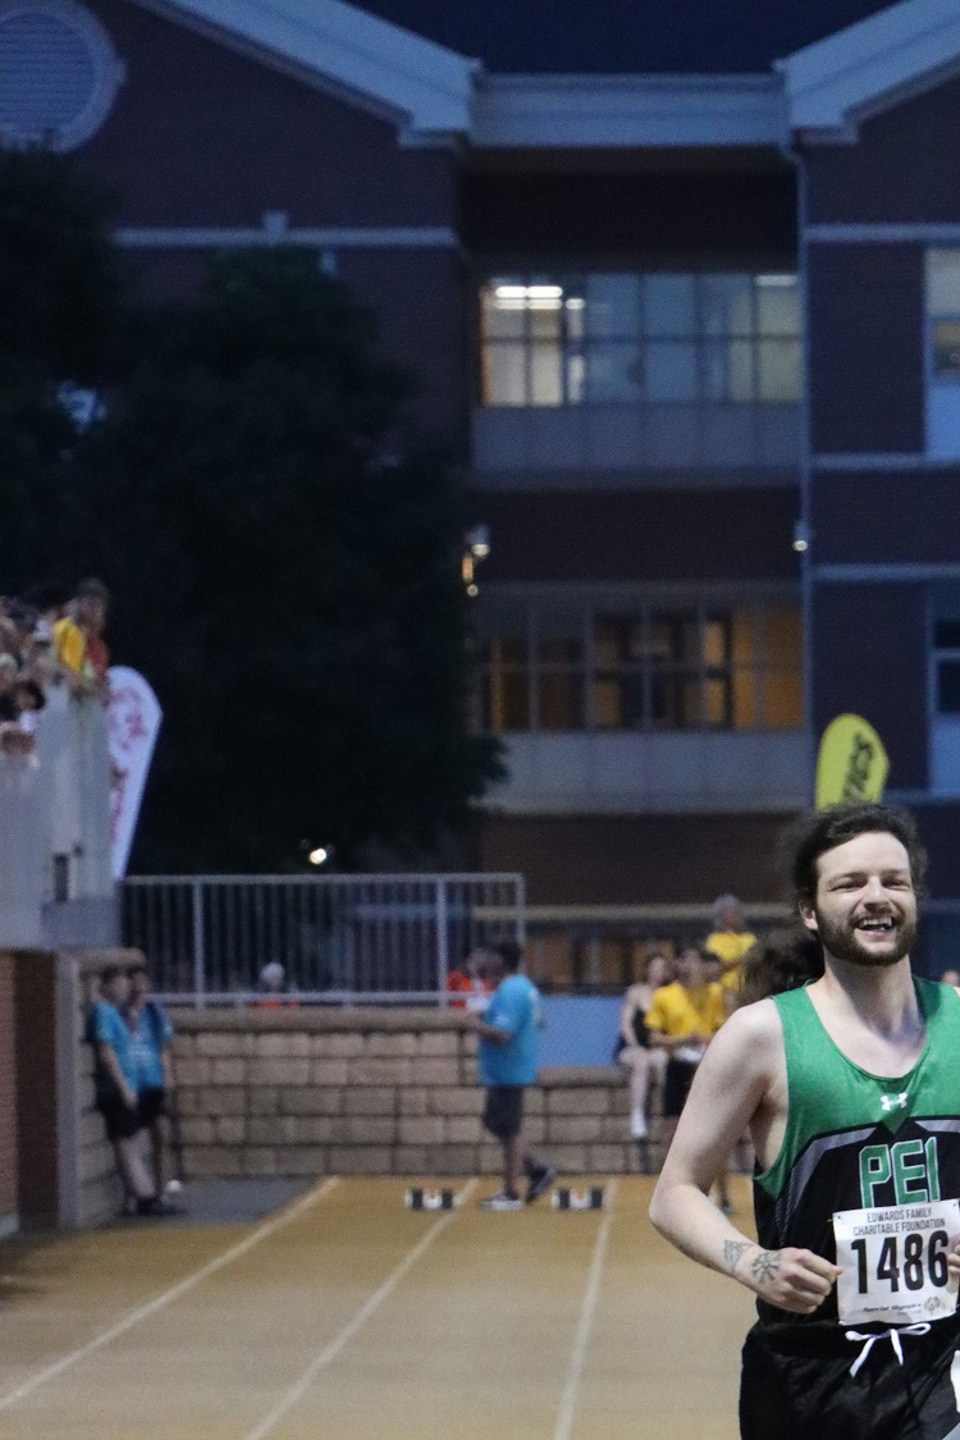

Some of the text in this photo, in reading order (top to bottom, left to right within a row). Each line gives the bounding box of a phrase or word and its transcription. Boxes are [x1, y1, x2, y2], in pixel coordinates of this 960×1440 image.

[859, 1136, 941, 1208] PEI
[853, 1218, 946, 1236] CHARITABLE FOUNDATION
[867, 1207, 933, 1223] EDWARDS FAMILY
[850, 1230, 949, 1295] 1486
